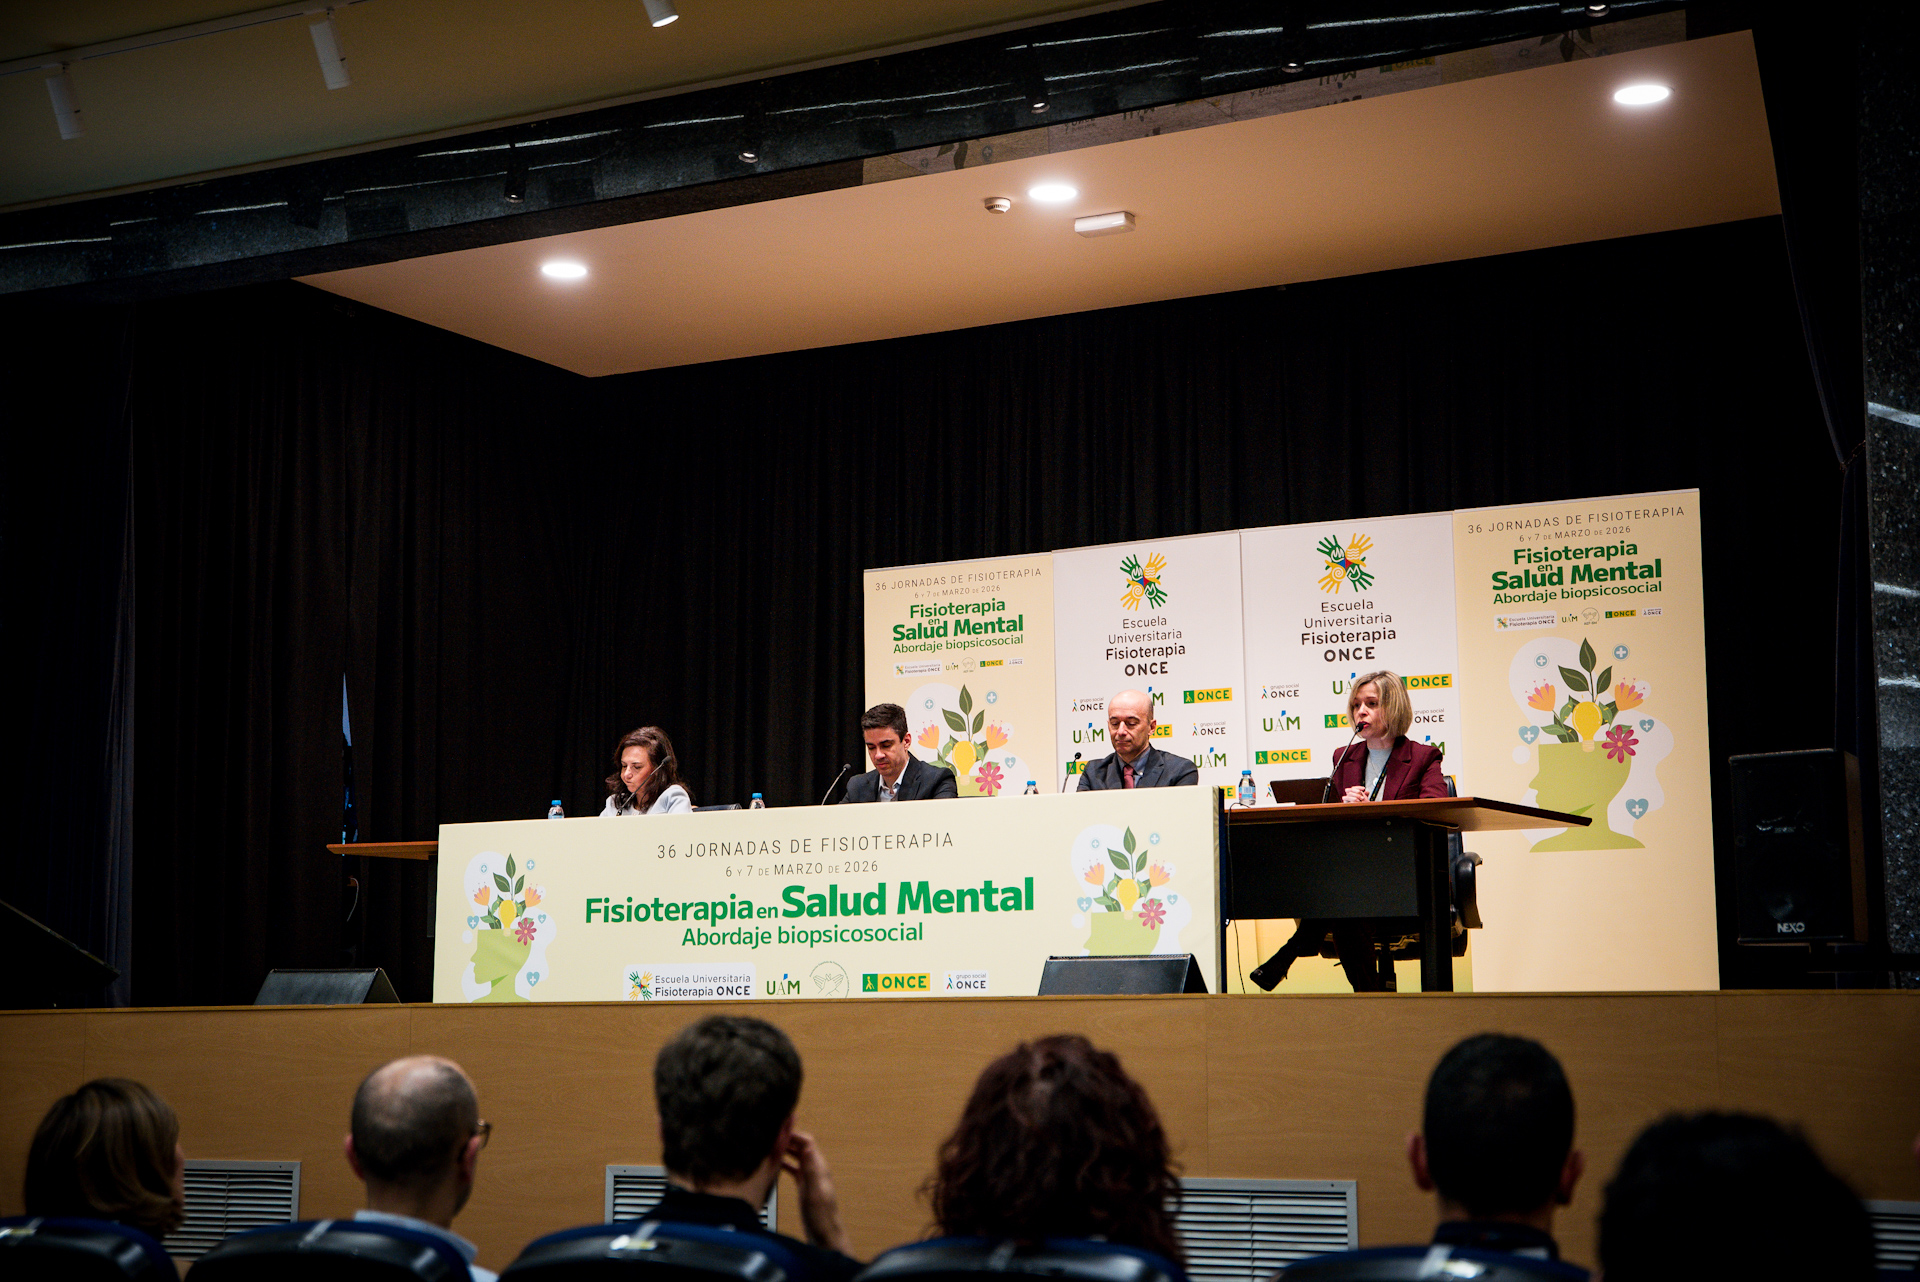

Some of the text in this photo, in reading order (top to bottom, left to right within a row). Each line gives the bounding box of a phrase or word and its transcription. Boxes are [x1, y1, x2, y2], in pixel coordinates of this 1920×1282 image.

[1468, 506, 1684, 534] 36 JORNADAS DE FISIOTERAPIA
[1554, 529, 1590, 539] MARZO
[1606, 526, 1631, 534] 2026
[1514, 540, 1637, 564] Fisioterapia
[1492, 558, 1661, 590] Salud Mental
[1537, 564, 1553, 572] en
[876, 568, 1042, 591] 36 JORNADAS DE FISIOTERAPIA
[942, 588, 970, 596] MARZO
[981, 584, 1000, 592] 2026
[1493, 581, 1661, 604] Abordaje biopsicosocial
[910, 598, 1005, 618] Fisioterapia
[1321, 599, 1374, 612] Escuela
[892, 614, 1023, 641] Salud Mental
[1122, 616, 1167, 629] Escuela
[1304, 612, 1392, 628] Universitaria
[1108, 628, 1182, 644] Universitaria
[1301, 627, 1396, 645] Fisioterapia
[893, 634, 1023, 654] Abordaje biopsicosocial
[1106, 642, 1185, 660] Fisioterapia
[1324, 646, 1375, 662] ONCE
[1124, 661, 1168, 676] ONCE
[1410, 676, 1449, 687] ONCE
[1197, 690, 1229, 700] ONCE
[1270, 689, 1299, 699] ONCE
[1080, 703, 1104, 711] ONCE
[1263, 716, 1300, 732] UAM
[1414, 715, 1444, 724] ONCE
[1073, 729, 1104, 743] UAM
[1200, 727, 1226, 735] ONCE
[1194, 753, 1226, 768] UAM
[1271, 751, 1307, 762] ONCE
[657, 832, 953, 859] 36 JORNADAS DE FISIOTERAPIA
[725, 866, 732, 877] 6
[747, 865, 753, 876] 7
[758, 868, 769, 876] DE
[774, 863, 823, 875] MARZO
[828, 865, 840, 874] DE
[845, 860, 878, 873] 2026
[586, 877, 1034, 927] Fisioterapia en Salud Mental
[1777, 922, 1805, 933] NEXO
[682, 922, 923, 950] Abordaje biopsicosocial
[655, 974, 751, 984] Escuela Universitaria
[882, 976, 926, 988] ONCE
[956, 980, 986, 989] ONCE
[655, 986, 750, 998] Fisioterapia ONCE
[766, 980, 800, 995] UAM
